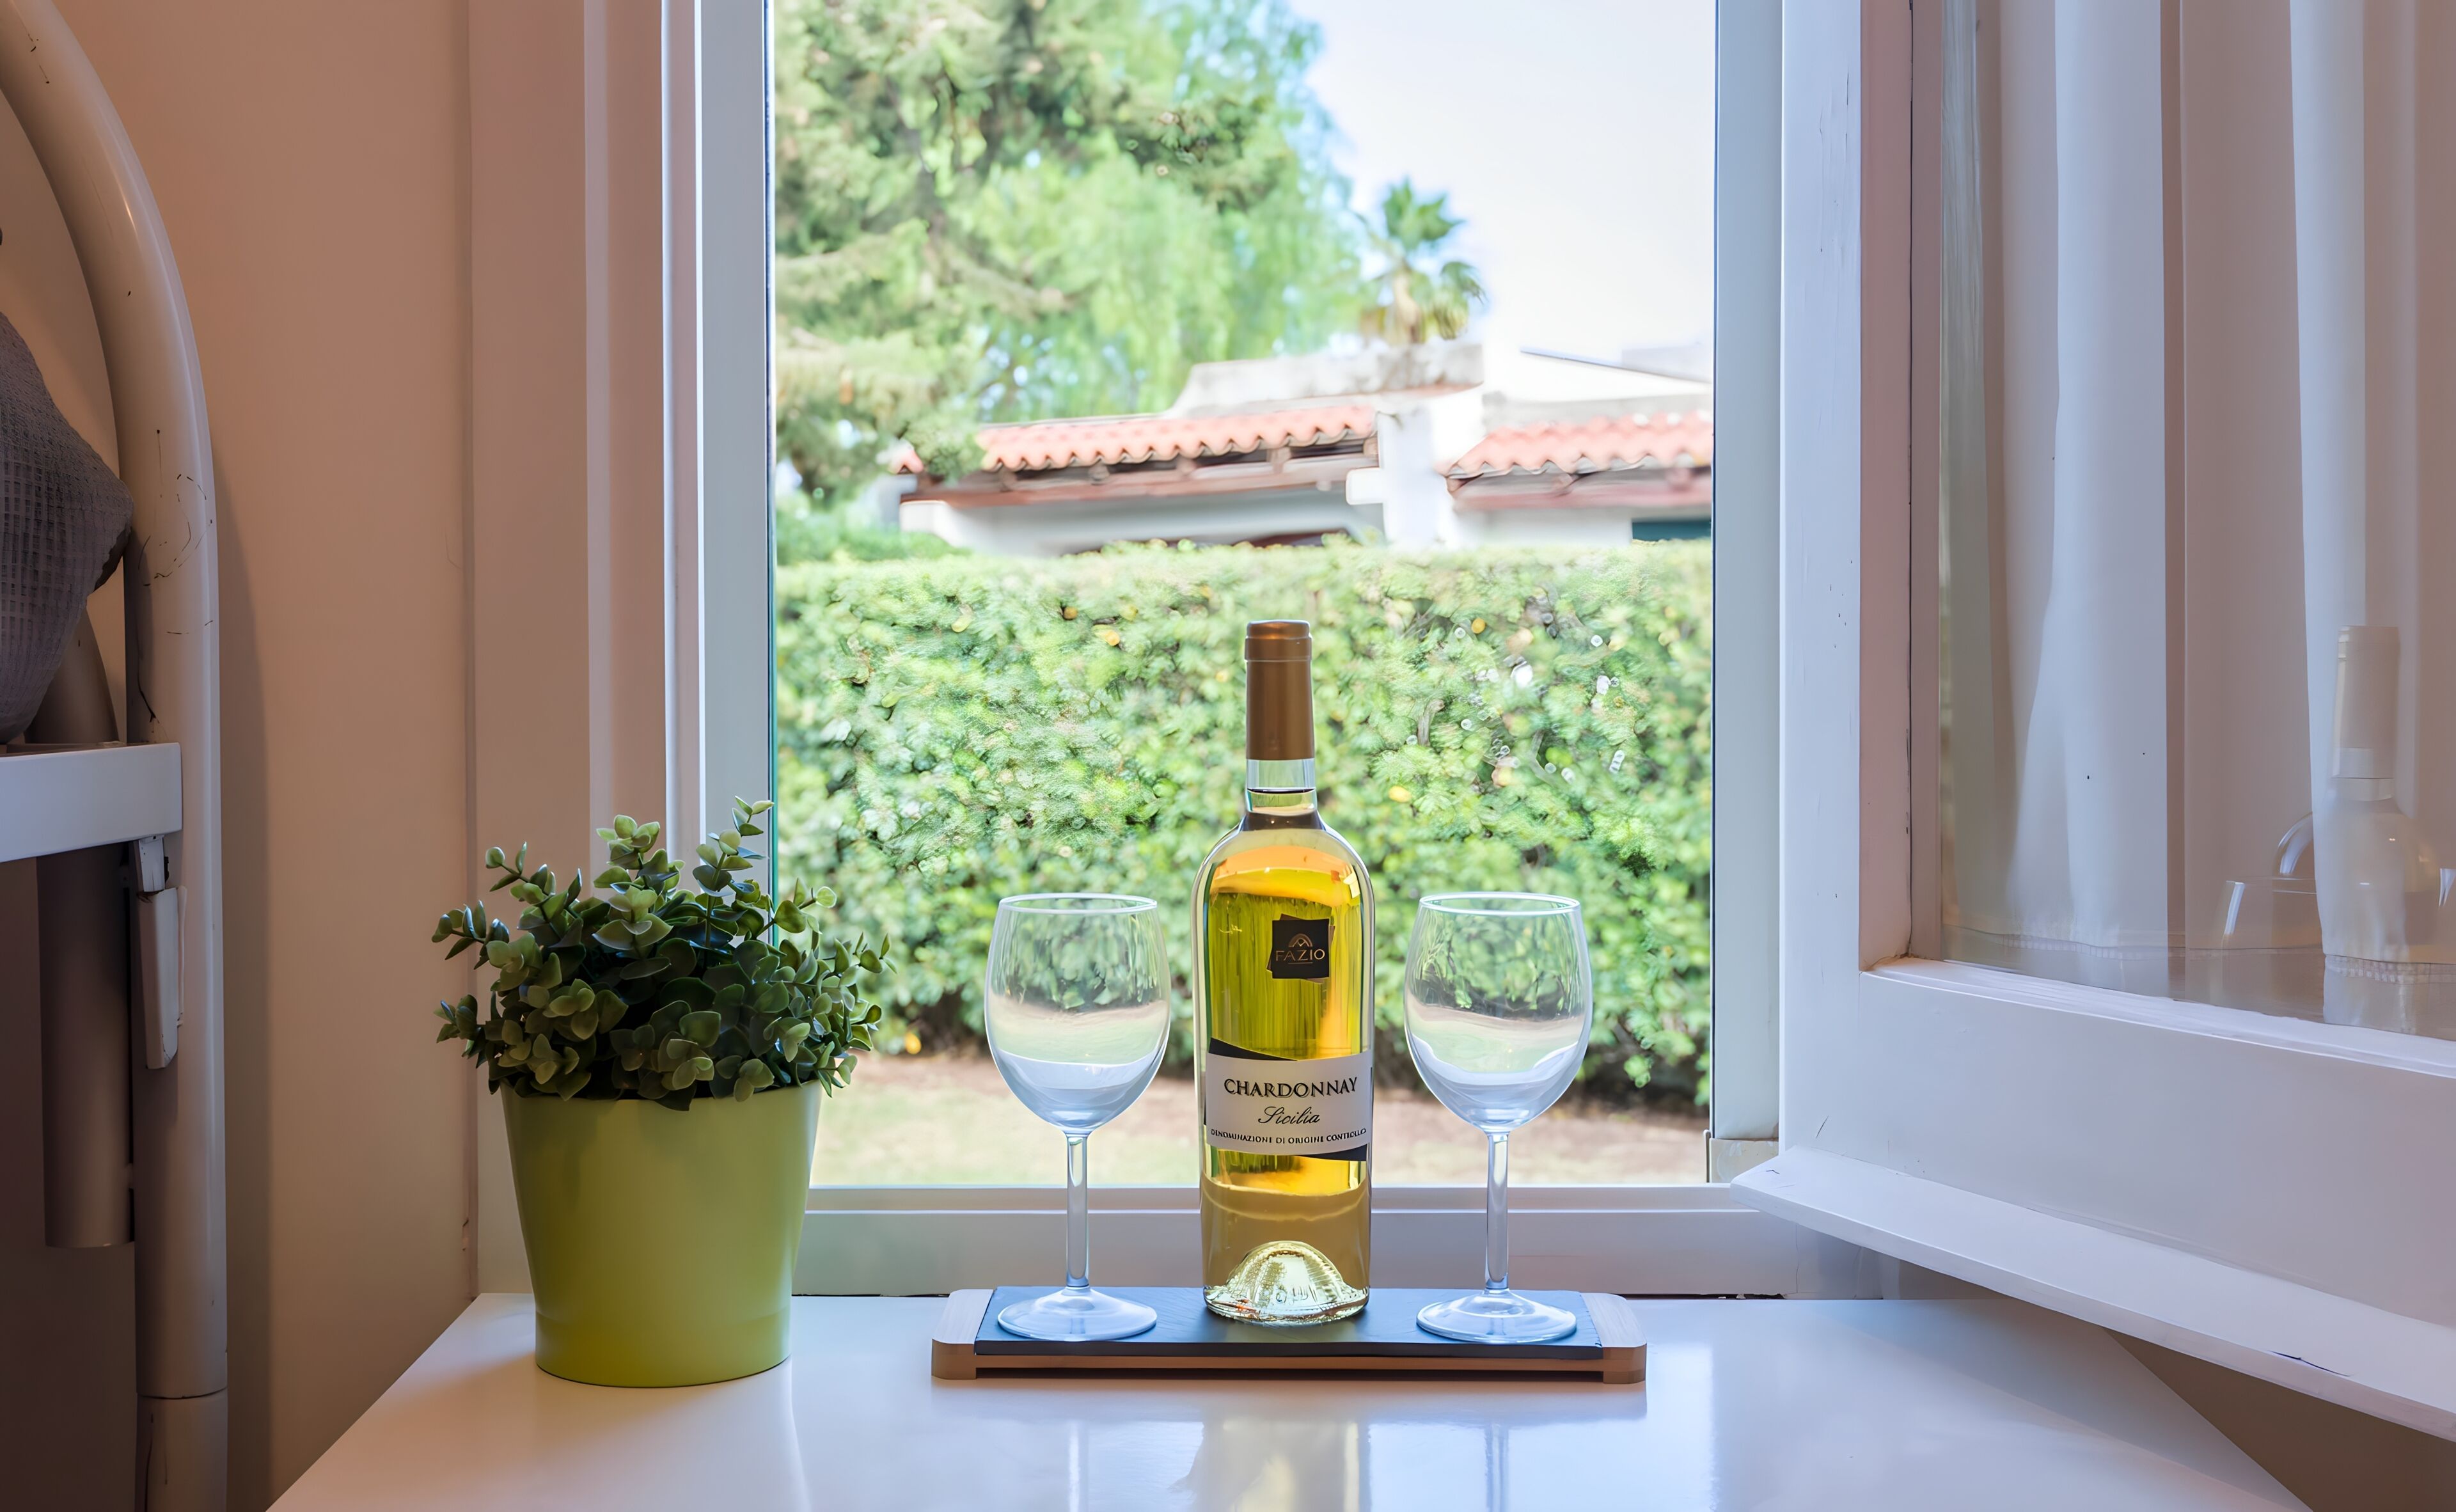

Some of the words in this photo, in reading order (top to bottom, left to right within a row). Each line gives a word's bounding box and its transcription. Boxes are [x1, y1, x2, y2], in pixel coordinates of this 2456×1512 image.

[1275, 949, 1325, 961] FAZIO
[1224, 1076, 1357, 1098] CHARDONNAY
[1257, 1106, 1321, 1124] Sicilia
